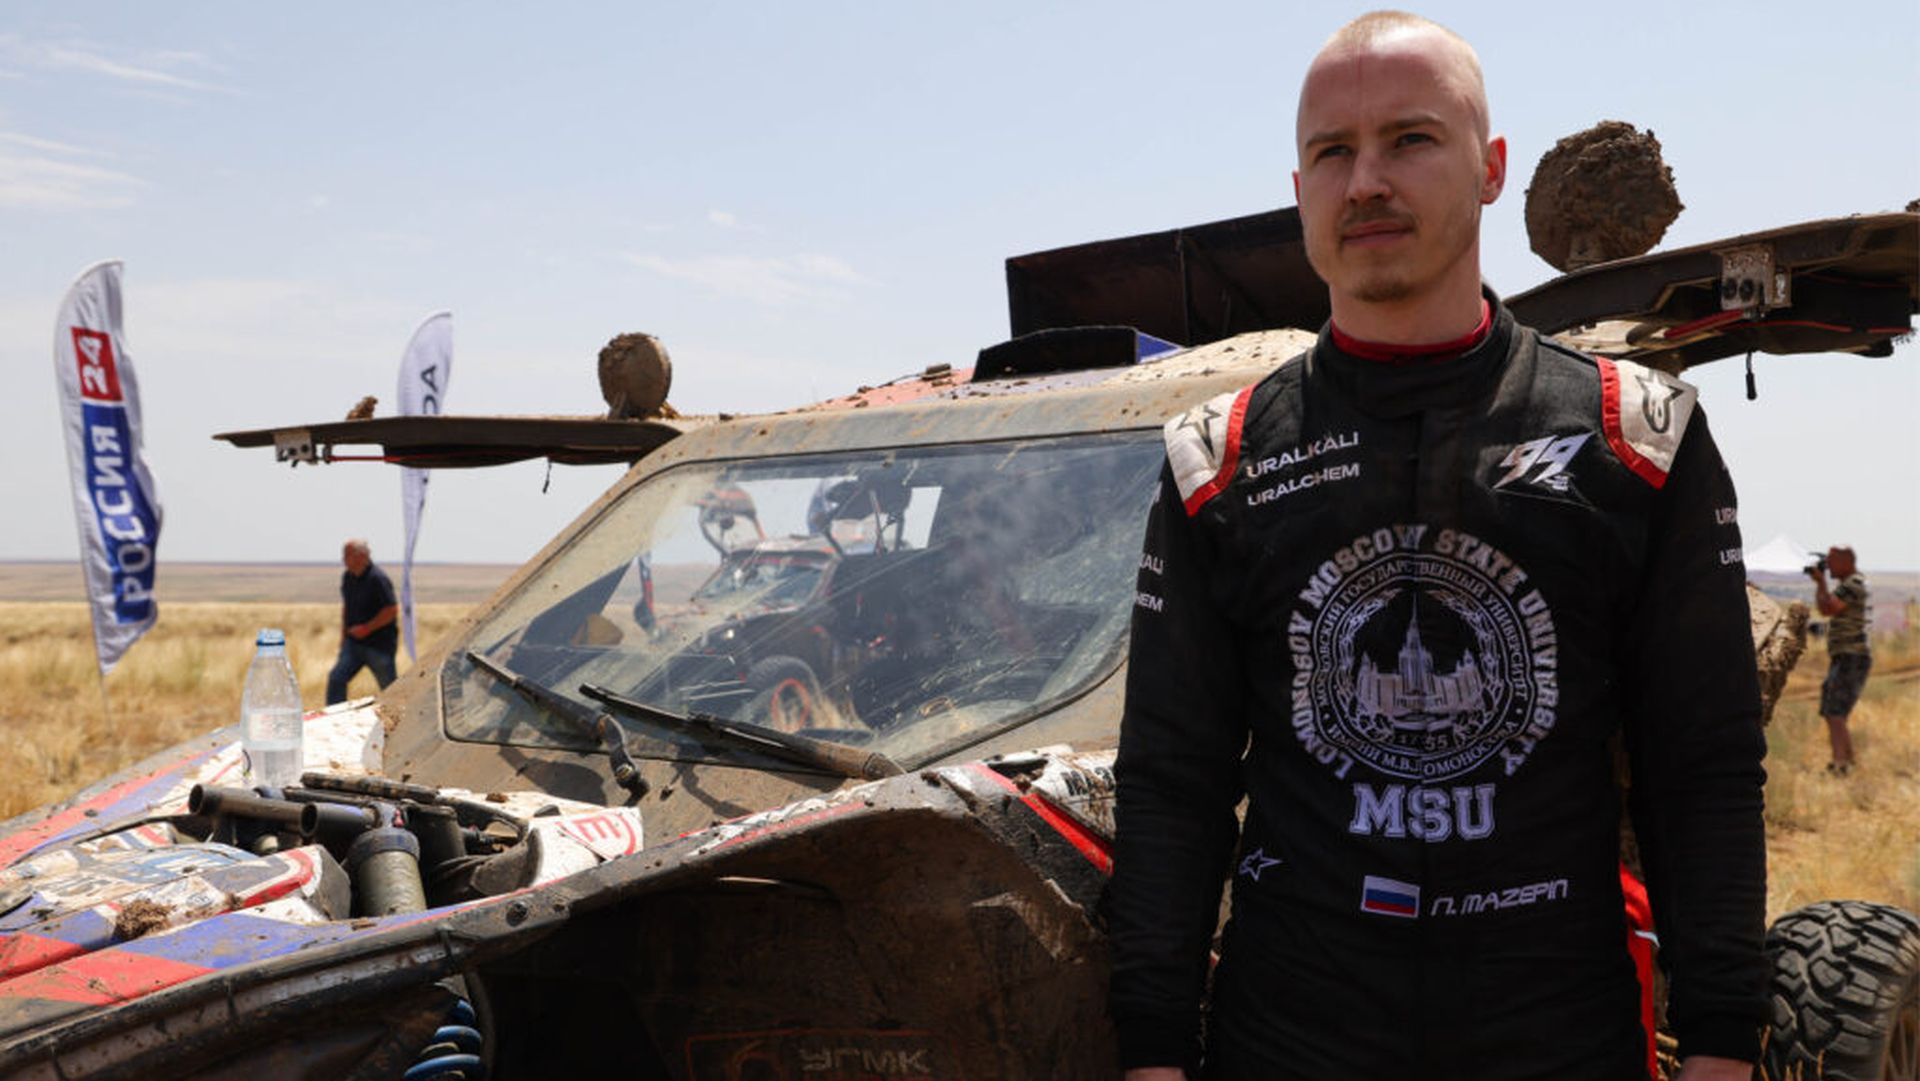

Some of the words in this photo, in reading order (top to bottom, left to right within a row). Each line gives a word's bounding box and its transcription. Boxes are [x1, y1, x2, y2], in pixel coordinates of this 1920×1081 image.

[79, 335, 109, 395] 24
[1246, 431, 1360, 478] URALKALI
[1247, 462, 1361, 506] URALCHEM
[91, 425, 153, 603] РОССИЯ
[1298, 523, 1428, 610] MOSCOW
[1434, 528, 1529, 596] STATE
[1349, 782, 1496, 843] MSU
[1459, 878, 1569, 915] MAZEPIN
[799, 1047, 931, 1074] УГМК
